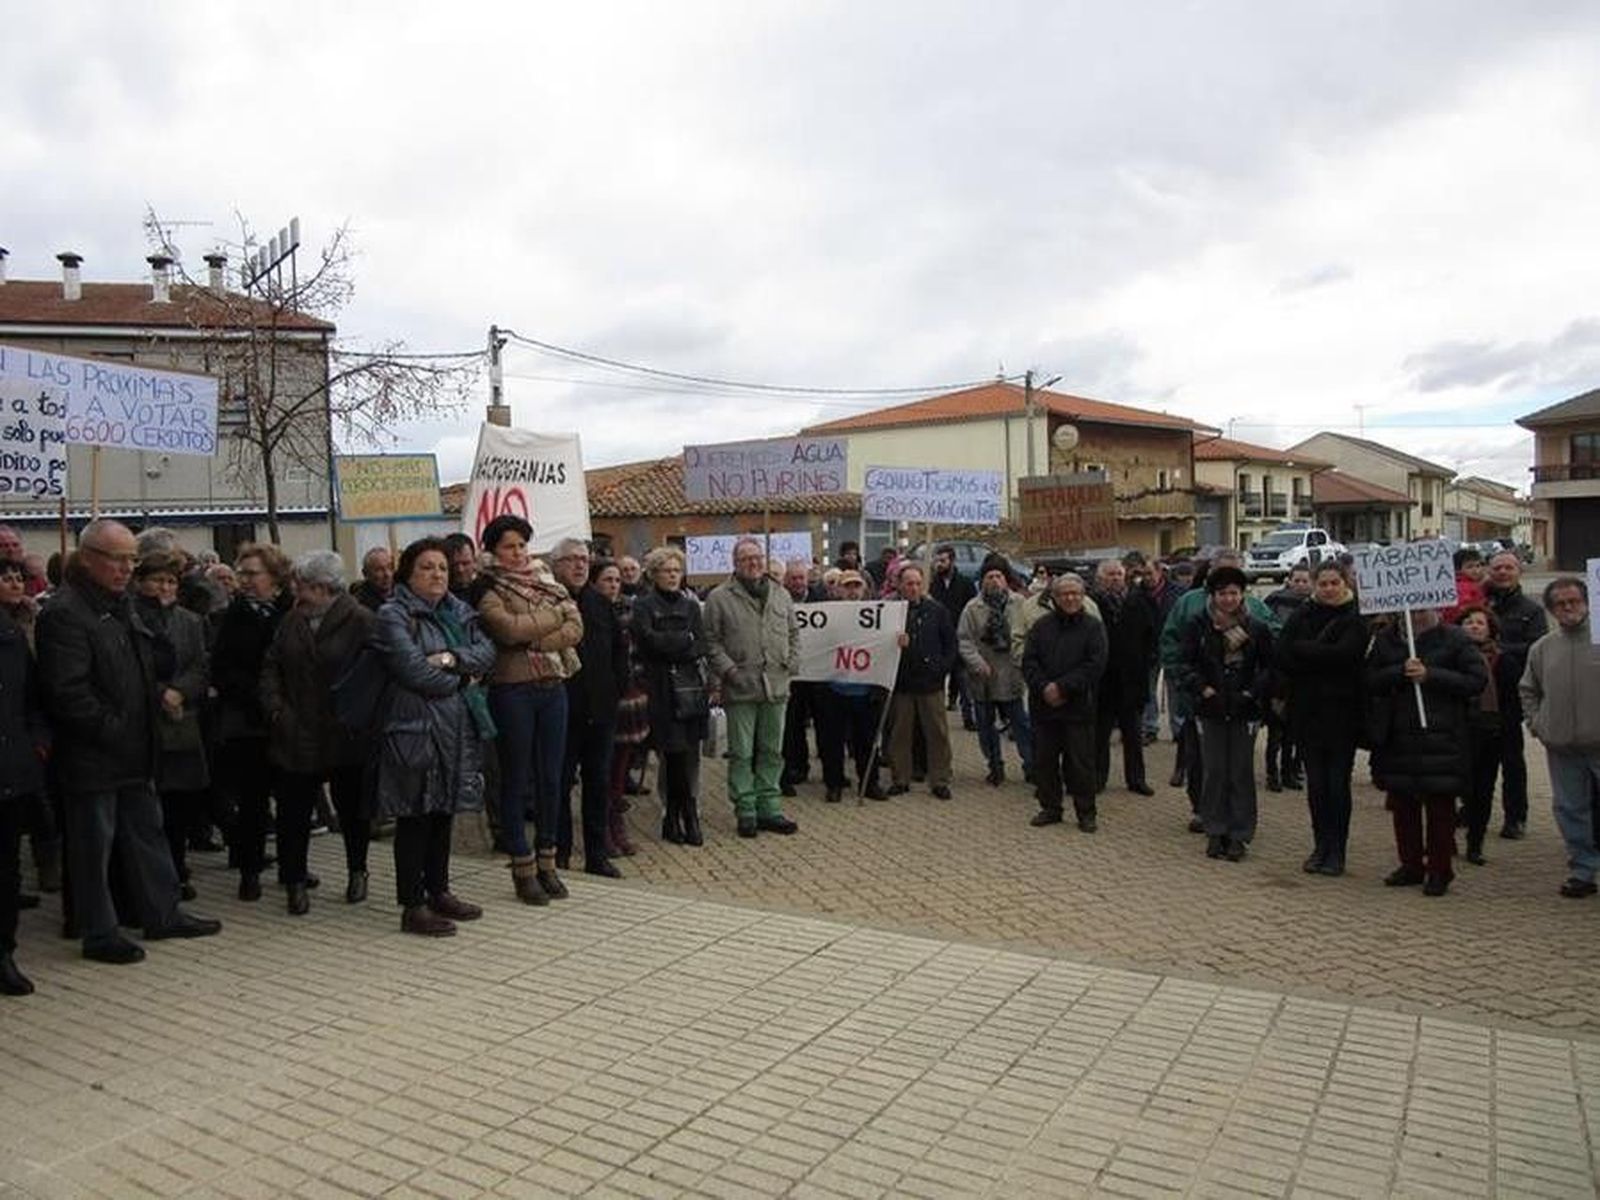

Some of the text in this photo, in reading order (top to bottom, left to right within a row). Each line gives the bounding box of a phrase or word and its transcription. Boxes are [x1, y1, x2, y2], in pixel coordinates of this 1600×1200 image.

[27, 352, 71, 386] LAS
[11, 399, 29, 414] a
[86, 396, 210, 431] A VOTAR
[66, 415, 215, 453] 6600 CERDITOS
[790, 442, 844, 465] AGUA
[708, 468, 841, 498] NO PURINES
[1356, 541, 1451, 569] TABARA
[1359, 564, 1452, 589] LIMPIA
[859, 603, 884, 629] SÍ
[835, 646, 871, 671] NO
